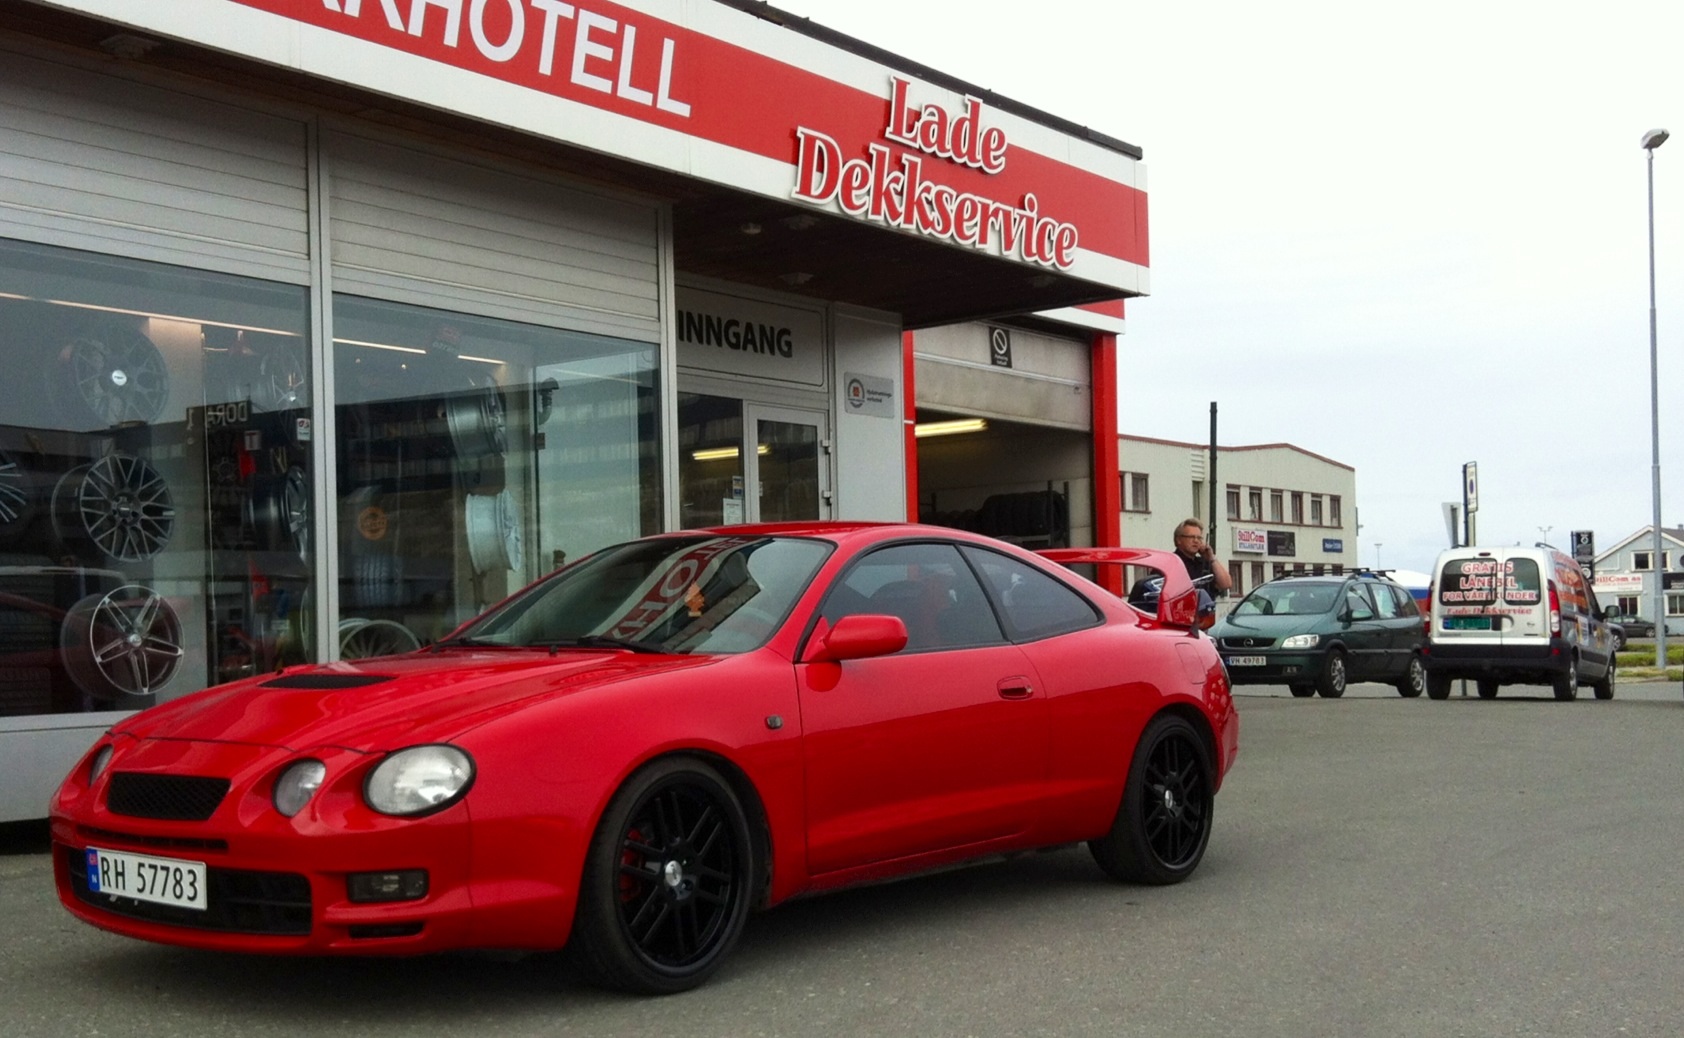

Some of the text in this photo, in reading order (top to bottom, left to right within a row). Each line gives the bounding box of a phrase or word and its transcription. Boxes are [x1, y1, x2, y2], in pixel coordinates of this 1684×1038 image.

[322, 0, 692, 118] HOTELL
[885, 75, 1007, 174] Lade
[791, 126, 1078, 271] Dekkservice
[678, 310, 793, 358] INNGANG
[1460, 575, 1518, 589] LÅNEBIL
[1461, 562, 1514, 574] GRATIS
[1443, 591, 1463, 601] FOR
[100, 856, 198, 902] RH 57783
